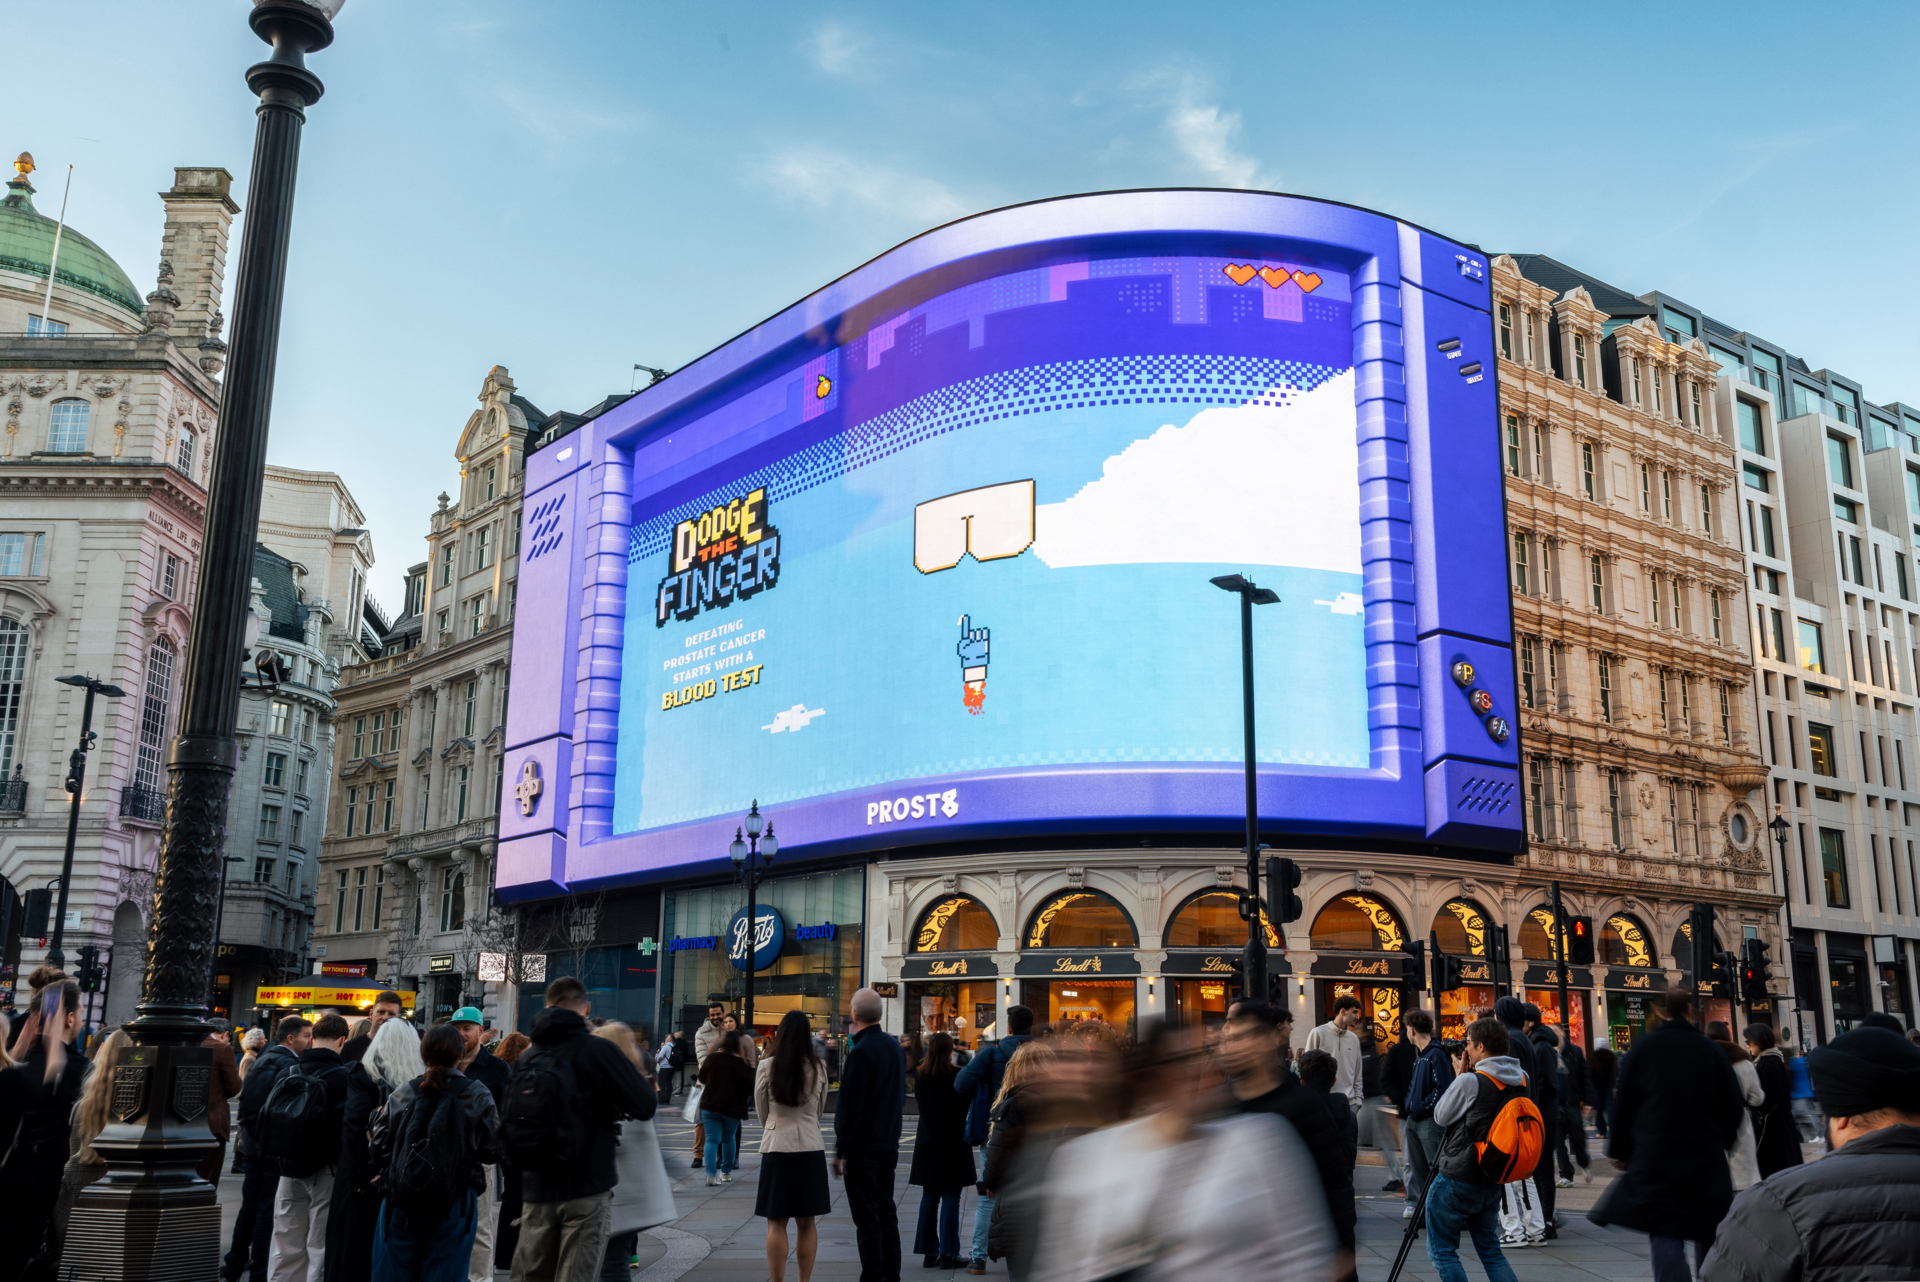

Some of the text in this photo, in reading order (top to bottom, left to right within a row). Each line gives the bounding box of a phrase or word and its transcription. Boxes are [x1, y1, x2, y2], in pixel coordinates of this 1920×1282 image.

[1446, 350, 1462, 359] START
[1466, 374, 1483, 384] SELECT
[148, 510, 201, 551] ALLIANCE LIFE OFF
[675, 488, 763, 573] DODGE
[698, 536, 738, 562] THE
[659, 536, 777, 620] FINGER
[685, 619, 743, 648] DEFEATING
[664, 628, 766, 671] PROSTATE CANCER
[673, 650, 753, 684] STARTS WITH A
[1464, 664, 1472, 680] P
[662, 664, 764, 711] BLOOD TEST
[1481, 692, 1491, 708] S
[1498, 720, 1509, 735] A
[582, 907, 597, 924] THE
[570, 924, 596, 942] VENUE
[796, 921, 836, 941] beauty
[669, 935, 716, 954] pharmacy
[928, 961, 958, 975] Lindt
[1052, 957, 1092, 972] Lindt
[1346, 960, 1380, 974] Lindt
[1460, 965, 1483, 979] Lindt
[1545, 970, 1558, 983] Lin
[1624, 974, 1645, 988] Lindt
[1334, 985, 1353, 993] Lindt
